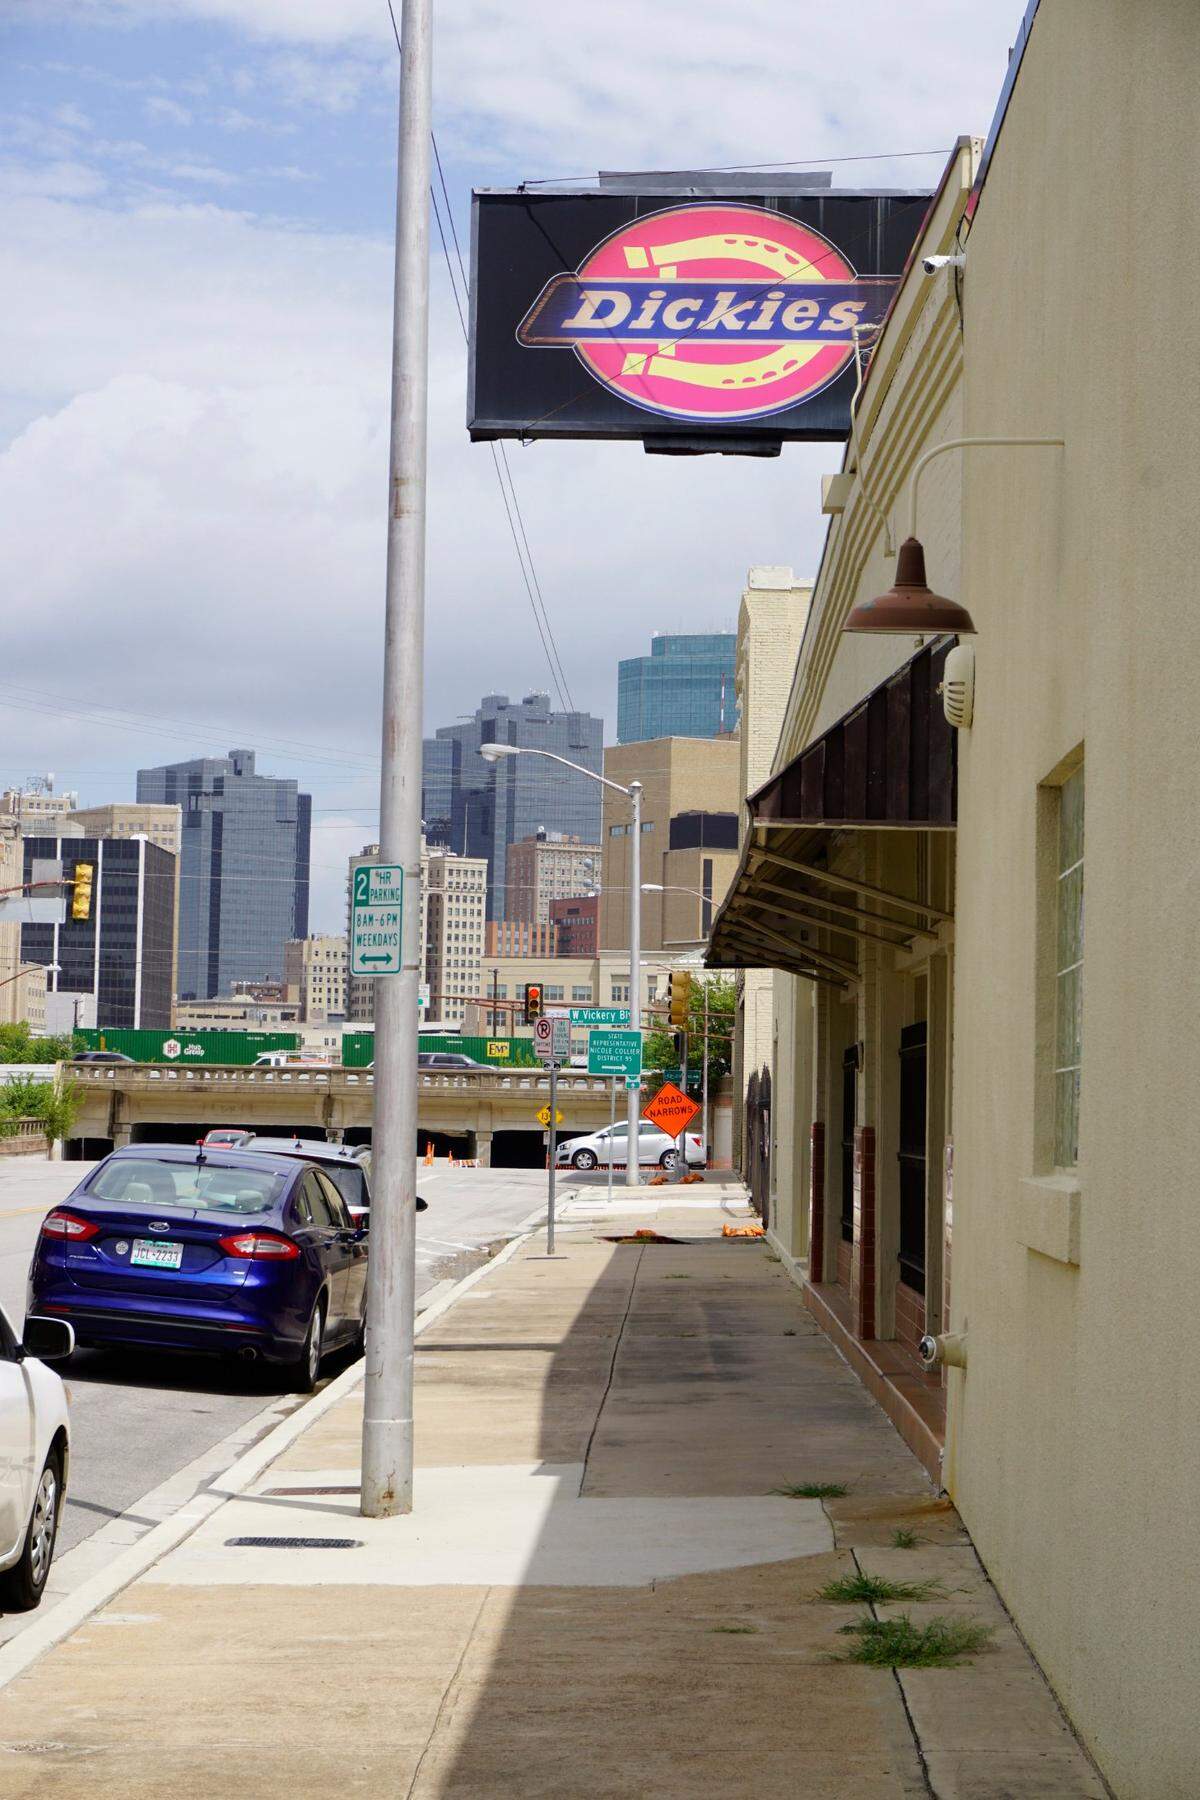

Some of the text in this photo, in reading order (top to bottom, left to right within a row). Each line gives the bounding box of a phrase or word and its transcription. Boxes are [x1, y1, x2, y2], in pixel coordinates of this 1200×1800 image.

[560, 289, 867, 332] Dickies
[379, 871, 391, 884] HR
[356, 873, 367, 900] 2
[370, 888, 400, 901] PARKING
[356, 933, 398, 946] WEEKDAYS
[572, 1010, 579, 1020] W
[583, 1010, 616, 1022] Vickery
[658, 1095, 682, 1105] ROAD
[650, 1105, 693, 1117] NARROWS
